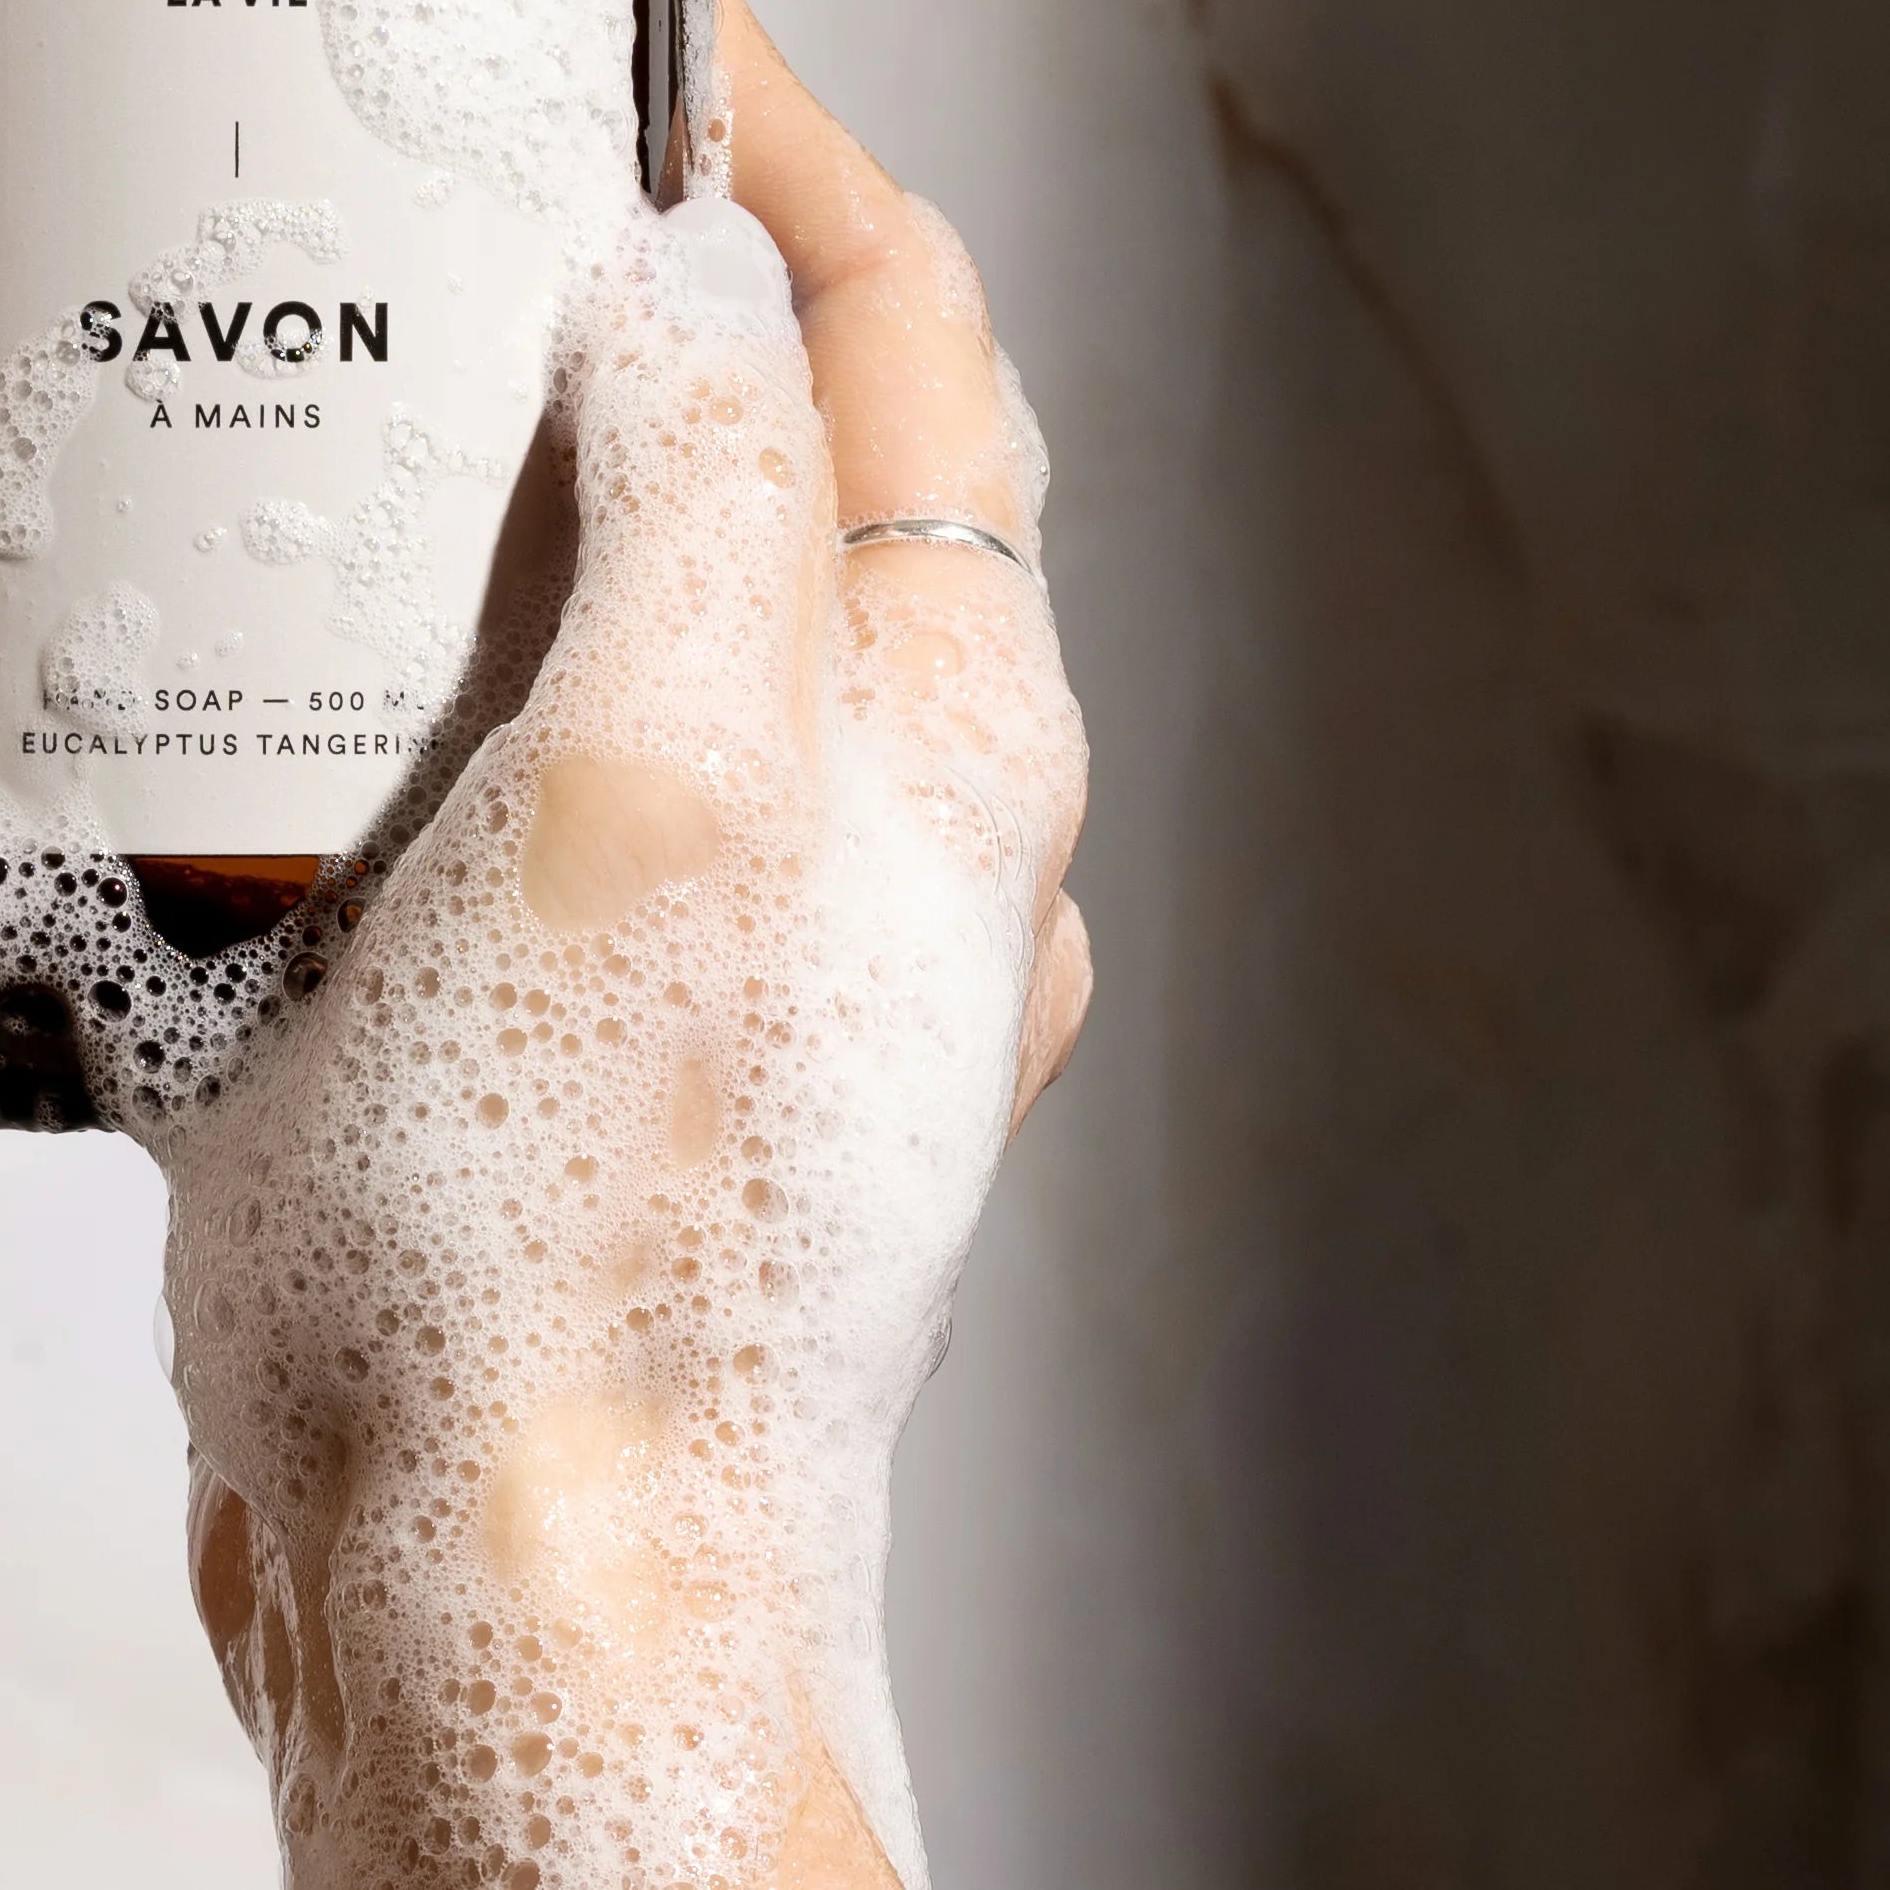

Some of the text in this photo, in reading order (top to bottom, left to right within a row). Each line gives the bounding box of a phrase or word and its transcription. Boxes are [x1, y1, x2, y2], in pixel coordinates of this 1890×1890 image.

[79, 300, 389, 362] SAVON
[149, 398, 321, 429] À MAINS
[154, 689, 243, 712] SOAP
[309, 691, 365, 712] 500
[22, 731, 444, 756] EUCALYPTUS TANGERI
